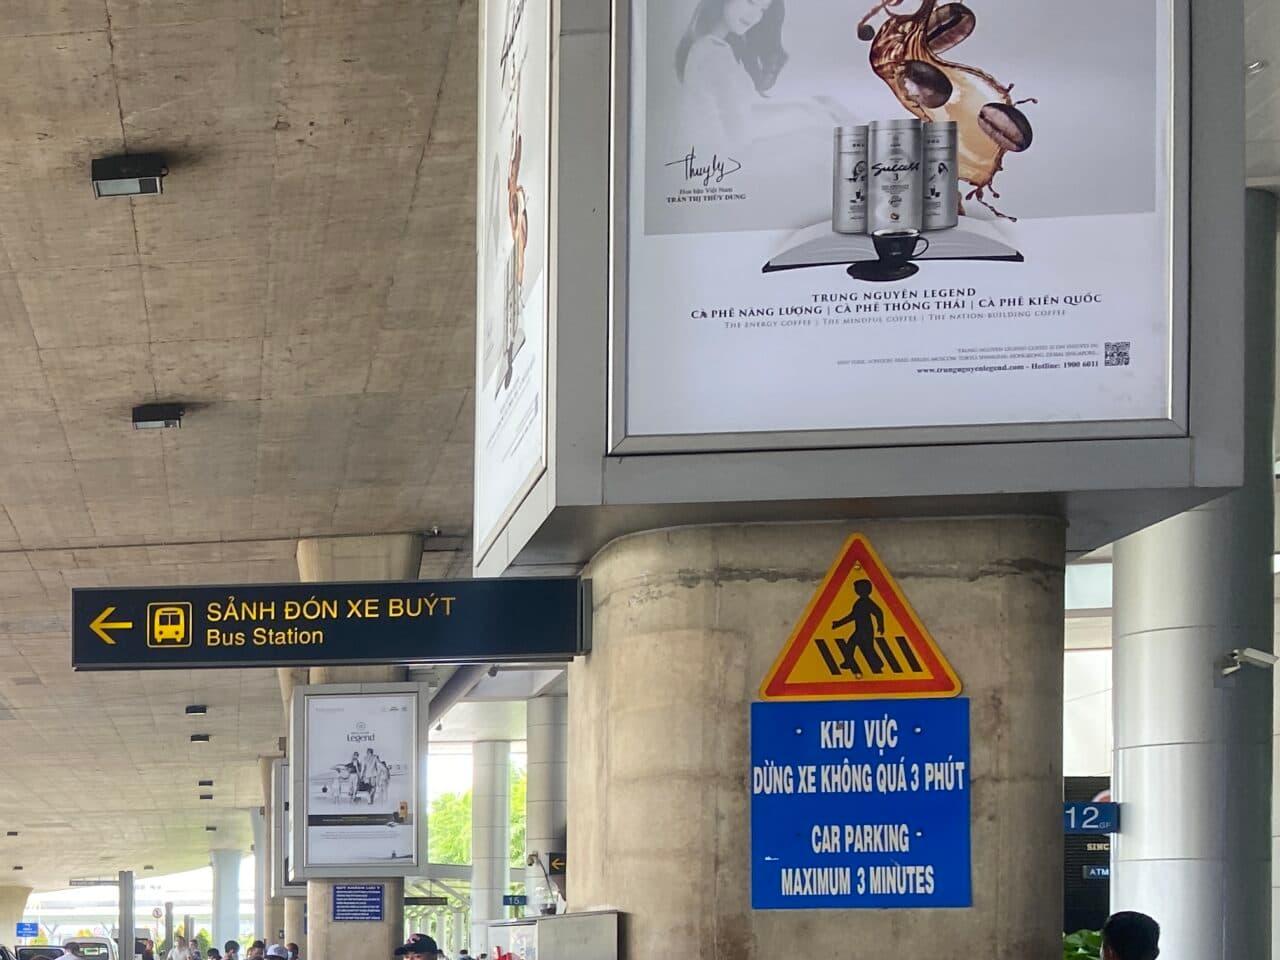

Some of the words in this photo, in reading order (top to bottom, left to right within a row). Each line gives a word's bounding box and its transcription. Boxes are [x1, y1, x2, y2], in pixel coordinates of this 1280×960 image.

[691, 308, 708, 319] CÀ
[711, 306, 735, 318] PHÊ
[835, 302, 852, 314] CÀ
[855, 301, 880, 313] PHÊ
[979, 296, 996, 308] CÀ
[999, 295, 1025, 307] PHÊ
[812, 292, 858, 303] TRUNG
[863, 288, 918, 301] NGUYÊN
[923, 287, 976, 299] LEGEND
[1031, 362, 1062, 370] Hotline:
[1063, 361, 1081, 369] 1900
[206, 596, 276, 622] SẢNH
[283, 595, 338, 621] ĐÓN
[346, 599, 380, 619] XE
[388, 592, 457, 618] BUÝT
[206, 629, 246, 647] Bus
[252, 627, 325, 646] Station
[820, 720, 855, 749] KHU
[864, 713, 898, 756] VỰC
[753, 759, 794, 795] DỪNG
[797, 765, 817, 793] XE
[821, 758, 872, 793] KHÔNG
[876, 756, 908, 795] QUÁ
[911, 763, 920, 792] 3
[924, 755, 966, 791] PHÚT
[1064, 806, 1099, 829] 12
[811, 825, 841, 854] CAR
[844, 823, 910, 853] PARKING
[781, 867, 851, 896] MAXIMUM
[856, 867, 866, 895] 3
[869, 865, 935, 895] MINUTES
[1089, 868, 1110, 876] ATM
